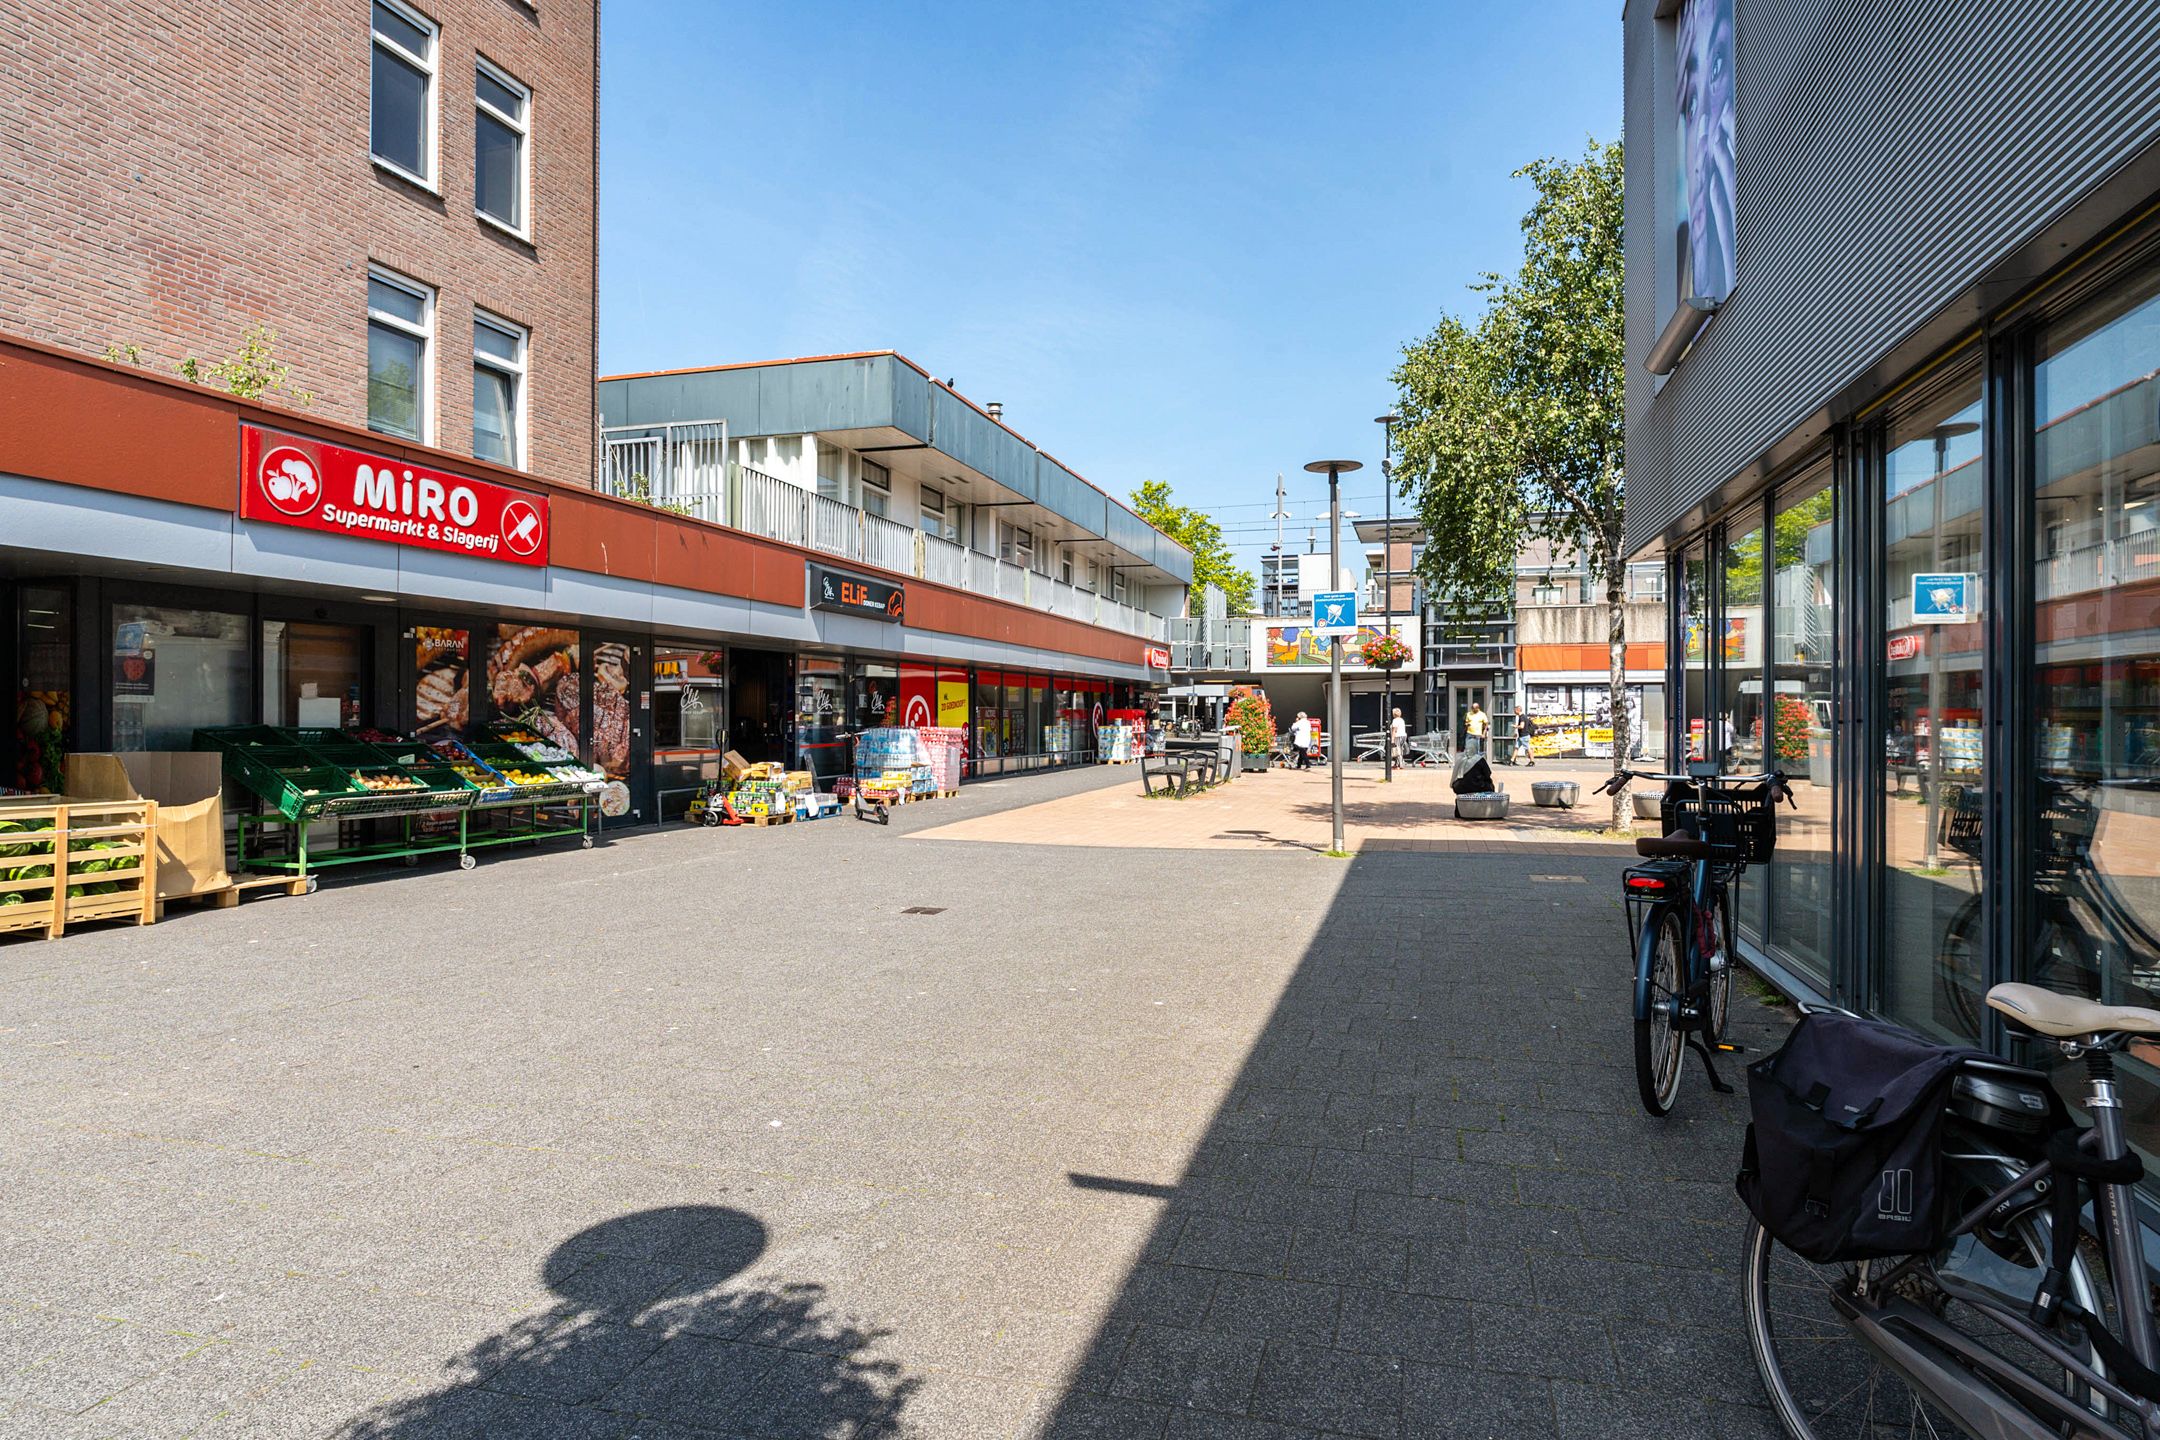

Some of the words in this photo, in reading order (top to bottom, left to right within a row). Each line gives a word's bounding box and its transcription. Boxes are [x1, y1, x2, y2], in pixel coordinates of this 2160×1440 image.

[322, 504, 424, 538] Supermarkt
[427, 524, 440, 540] &
[443, 527, 499, 553] Slagerij
[435, 639, 464, 649] BARAN
[1878, 1213, 1913, 1222] BASIL
